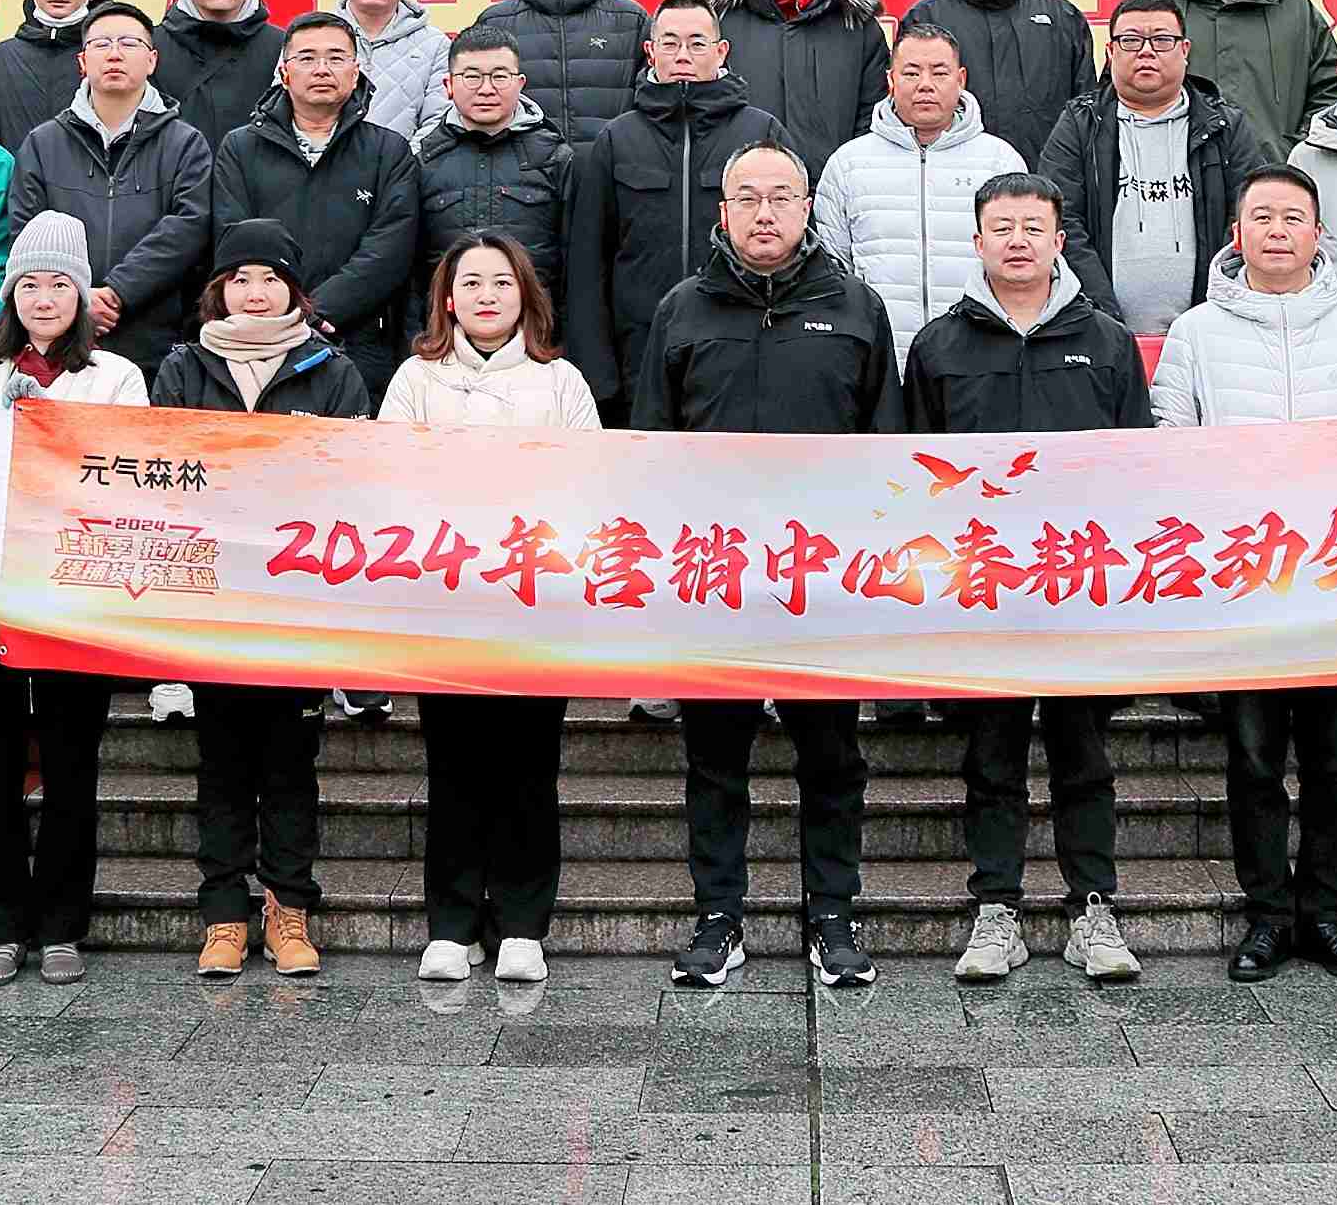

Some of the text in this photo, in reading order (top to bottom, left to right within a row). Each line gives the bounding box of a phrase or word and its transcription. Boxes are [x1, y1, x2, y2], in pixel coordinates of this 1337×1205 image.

[79, 454, 208, 492] 元气森林
[115, 517, 167, 532] 2024
